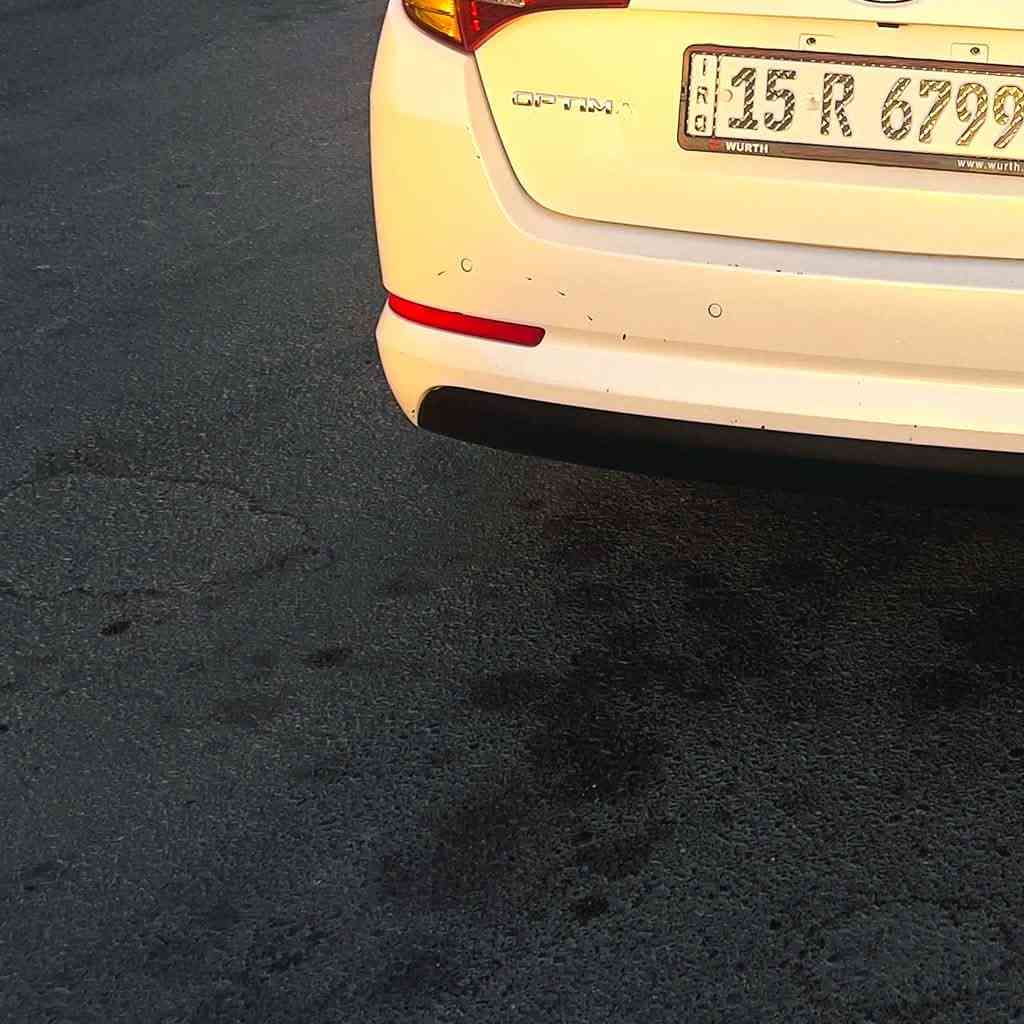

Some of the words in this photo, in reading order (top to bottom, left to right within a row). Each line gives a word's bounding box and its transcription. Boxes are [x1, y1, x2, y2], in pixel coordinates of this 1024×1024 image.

[694, 57, 708, 133] IRQ
[727, 67, 798, 131] 15
[820, 72, 856, 137] R
